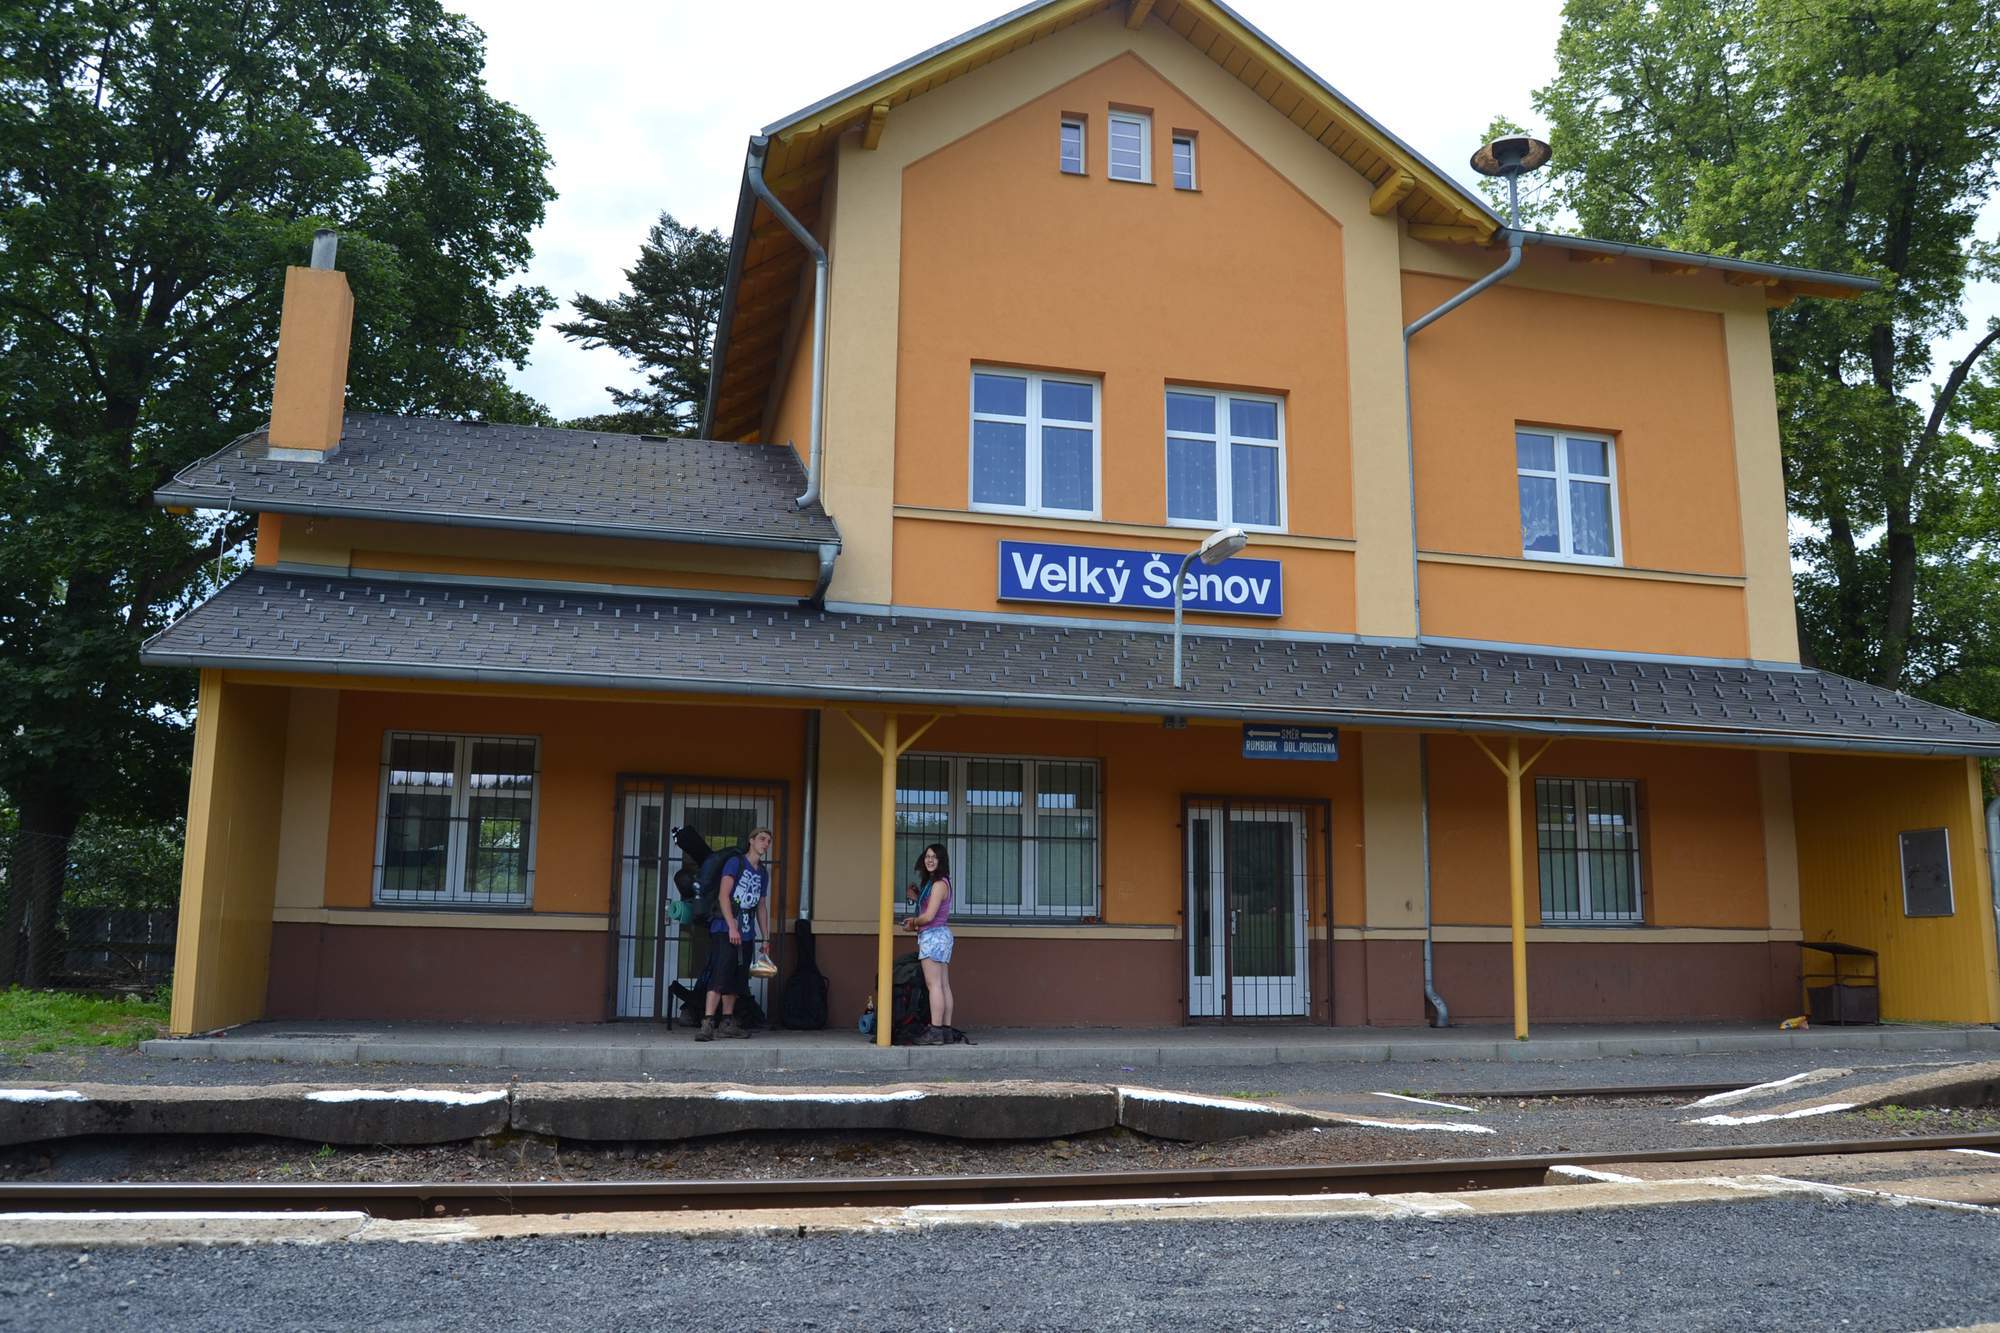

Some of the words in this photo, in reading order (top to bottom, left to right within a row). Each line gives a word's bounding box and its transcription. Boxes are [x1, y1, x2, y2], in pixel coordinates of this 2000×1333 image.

[1011, 552, 1131, 604] Velký
[1142, 553, 1272, 605] Šenov
[1246, 740, 1278, 752] RUMBURK
